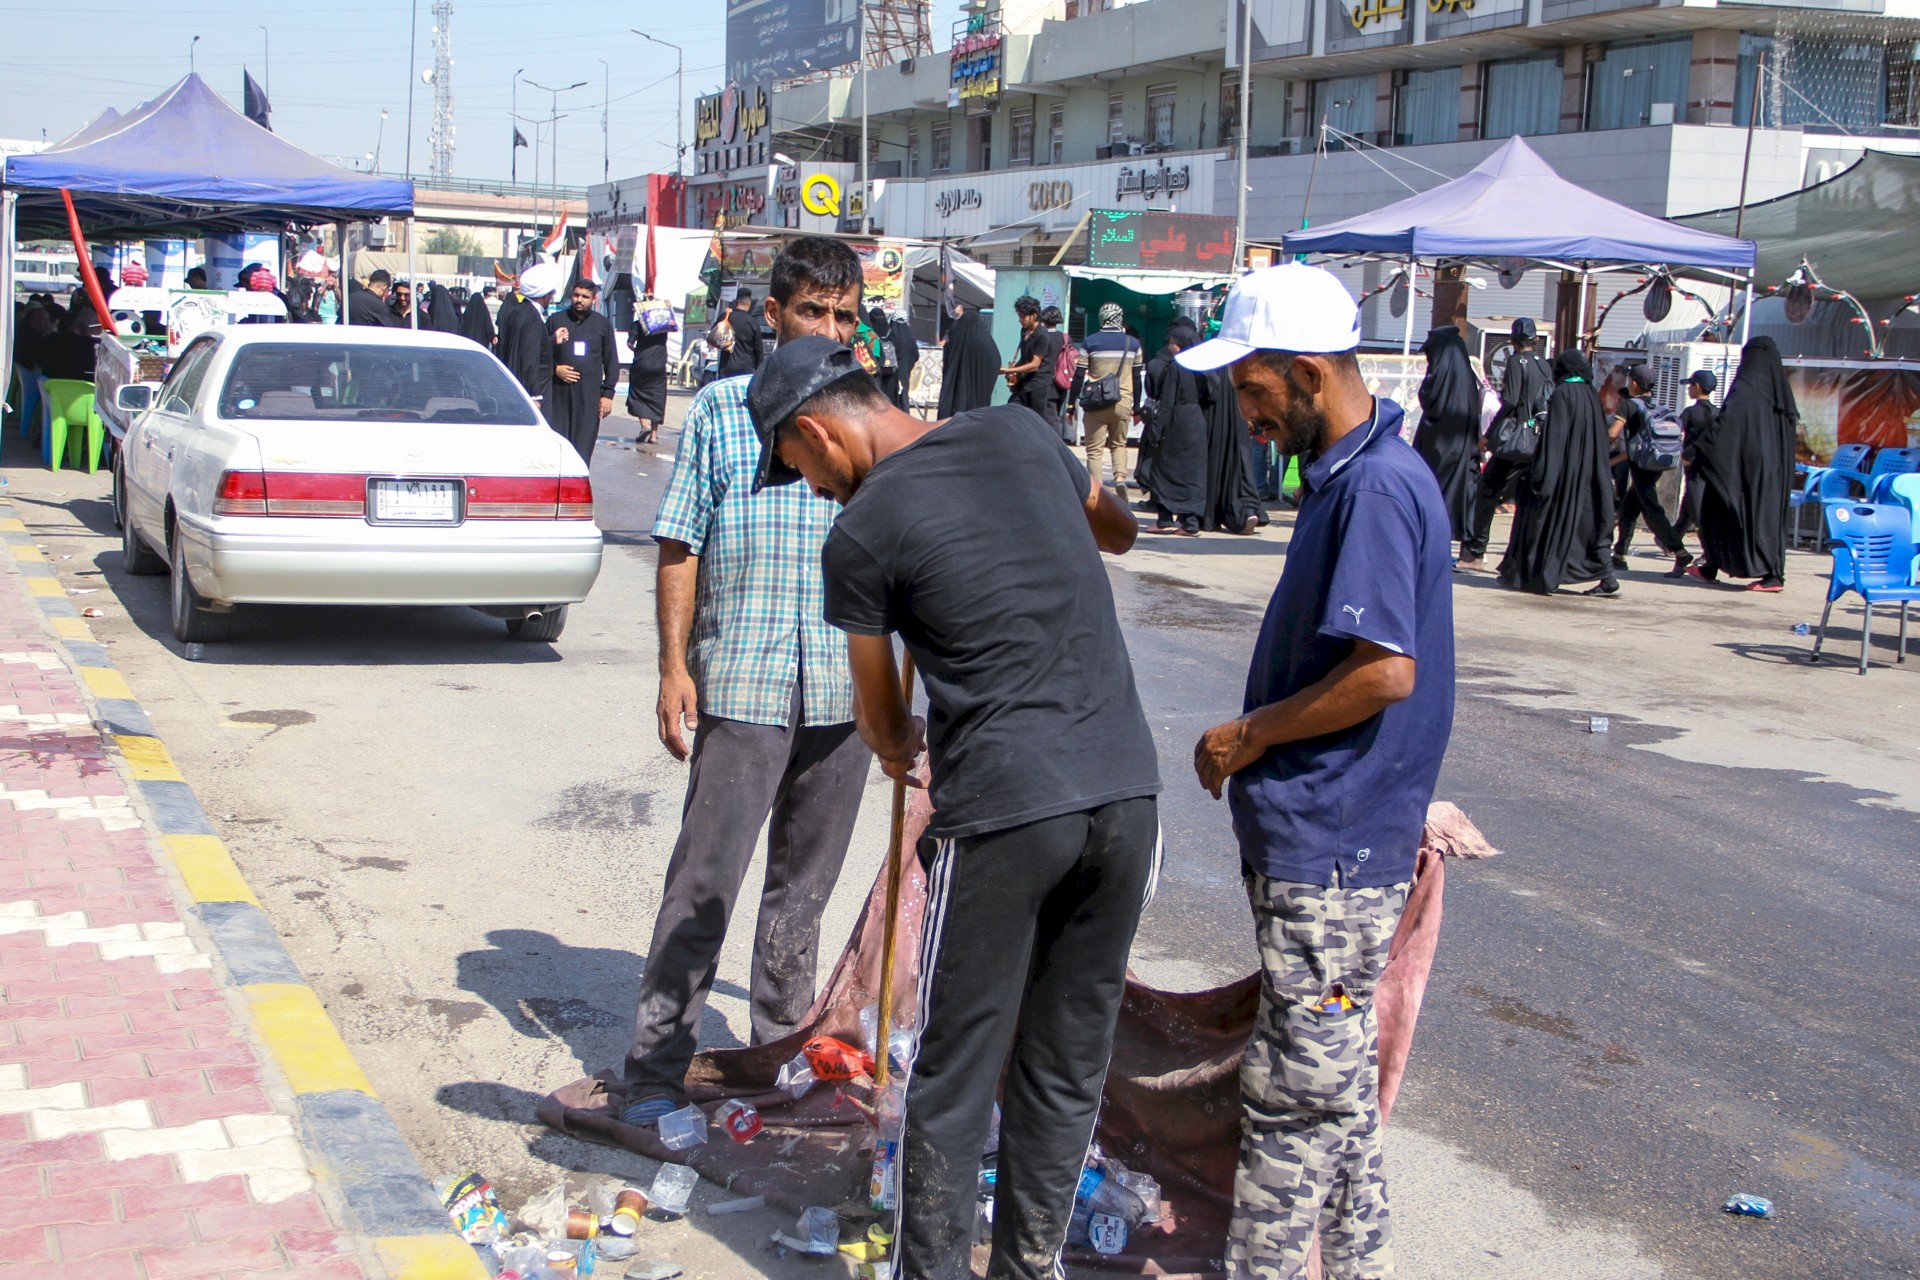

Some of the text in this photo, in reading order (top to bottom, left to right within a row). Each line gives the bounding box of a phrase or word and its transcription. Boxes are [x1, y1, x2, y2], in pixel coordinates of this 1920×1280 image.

[738, 86, 766, 142] شاورما
[960, 188, 982, 210] ملك
[1027, 180, 1073, 211] COCO
